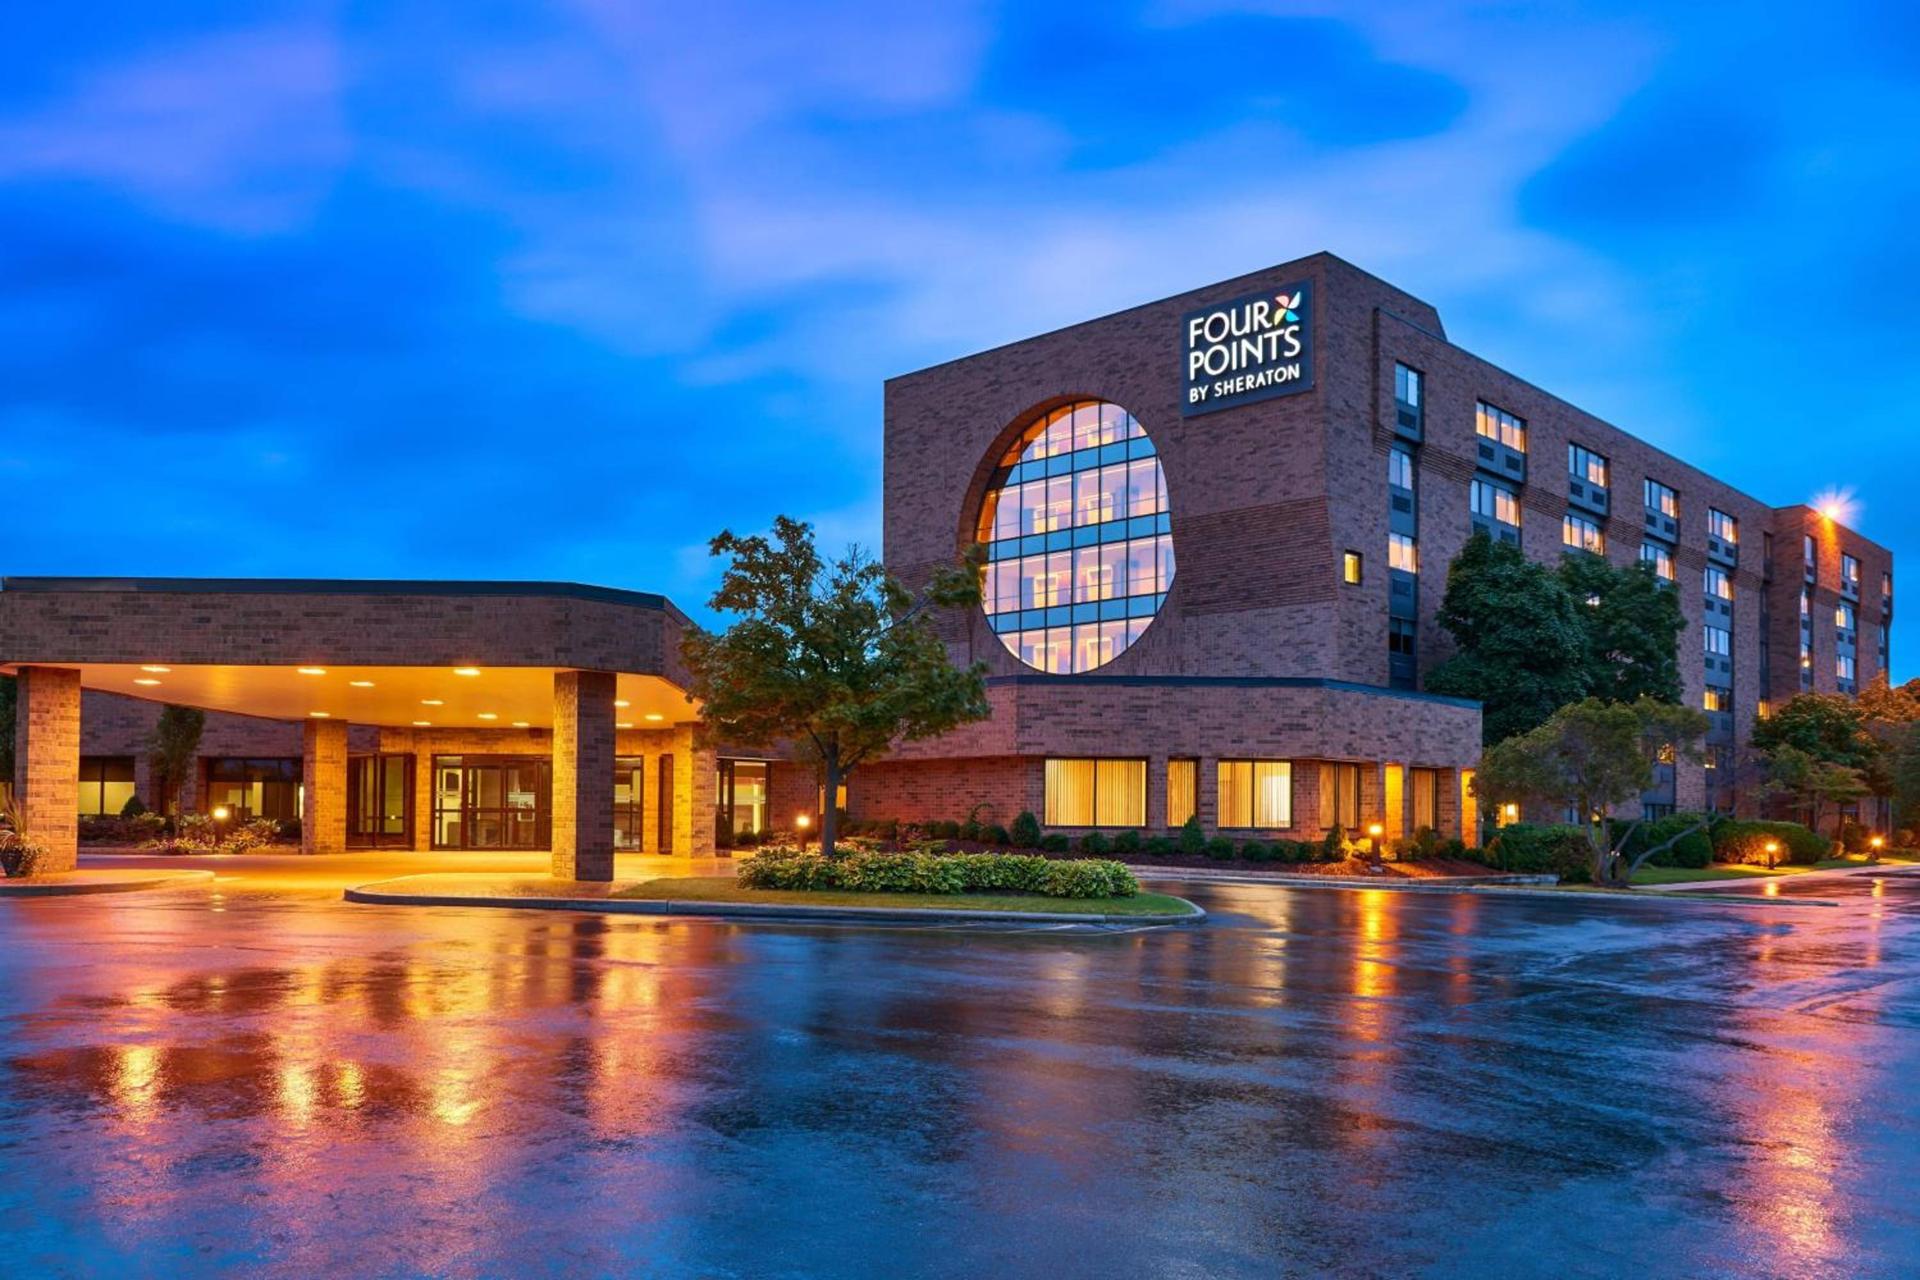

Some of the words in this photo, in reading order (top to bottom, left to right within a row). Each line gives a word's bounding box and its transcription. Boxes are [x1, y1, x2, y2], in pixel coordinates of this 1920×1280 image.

[1189, 301, 1272, 348] FOUR
[1189, 325, 1301, 381] POINTS
[1189, 385, 1209, 403] BY
[1214, 363, 1300, 397] SHERATON
